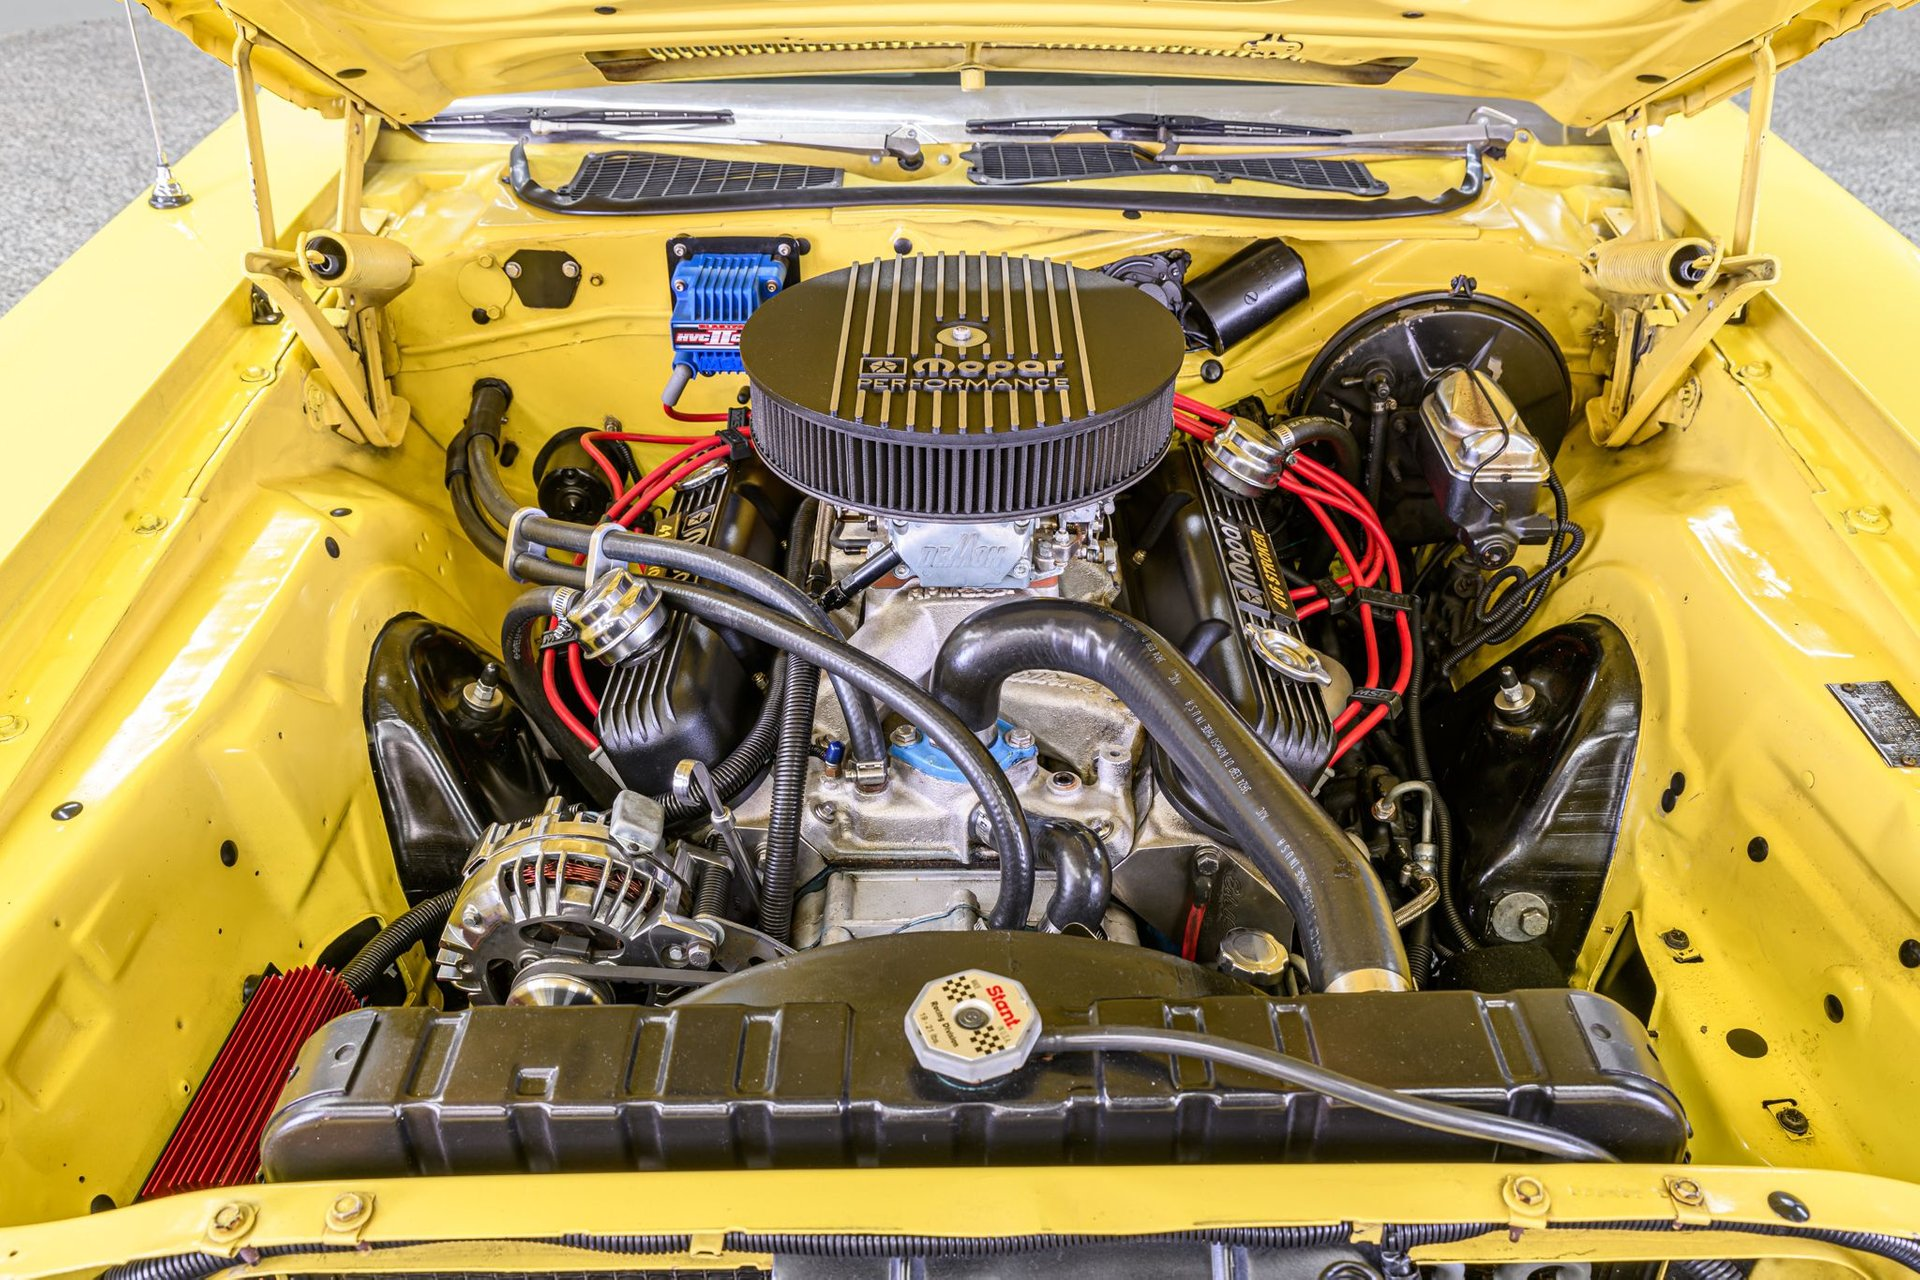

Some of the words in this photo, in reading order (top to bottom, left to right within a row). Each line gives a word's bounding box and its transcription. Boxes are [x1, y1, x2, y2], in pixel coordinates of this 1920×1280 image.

[676, 333, 710, 342] HVC
[913, 358, 1065, 380] Mopar
[857, 378, 1070, 392] PERFORMANCE
[1250, 528, 1281, 587] STROKER
[1272, 585, 1289, 610] 416
[1200, 723, 1215, 740] MADE
[986, 985, 1021, 1030] Stant
[920, 1012, 929, 1023] 19
[925, 1025, 935, 1036] 21
[930, 1001, 945, 1023] Racing
[942, 1022, 959, 1048] Division
